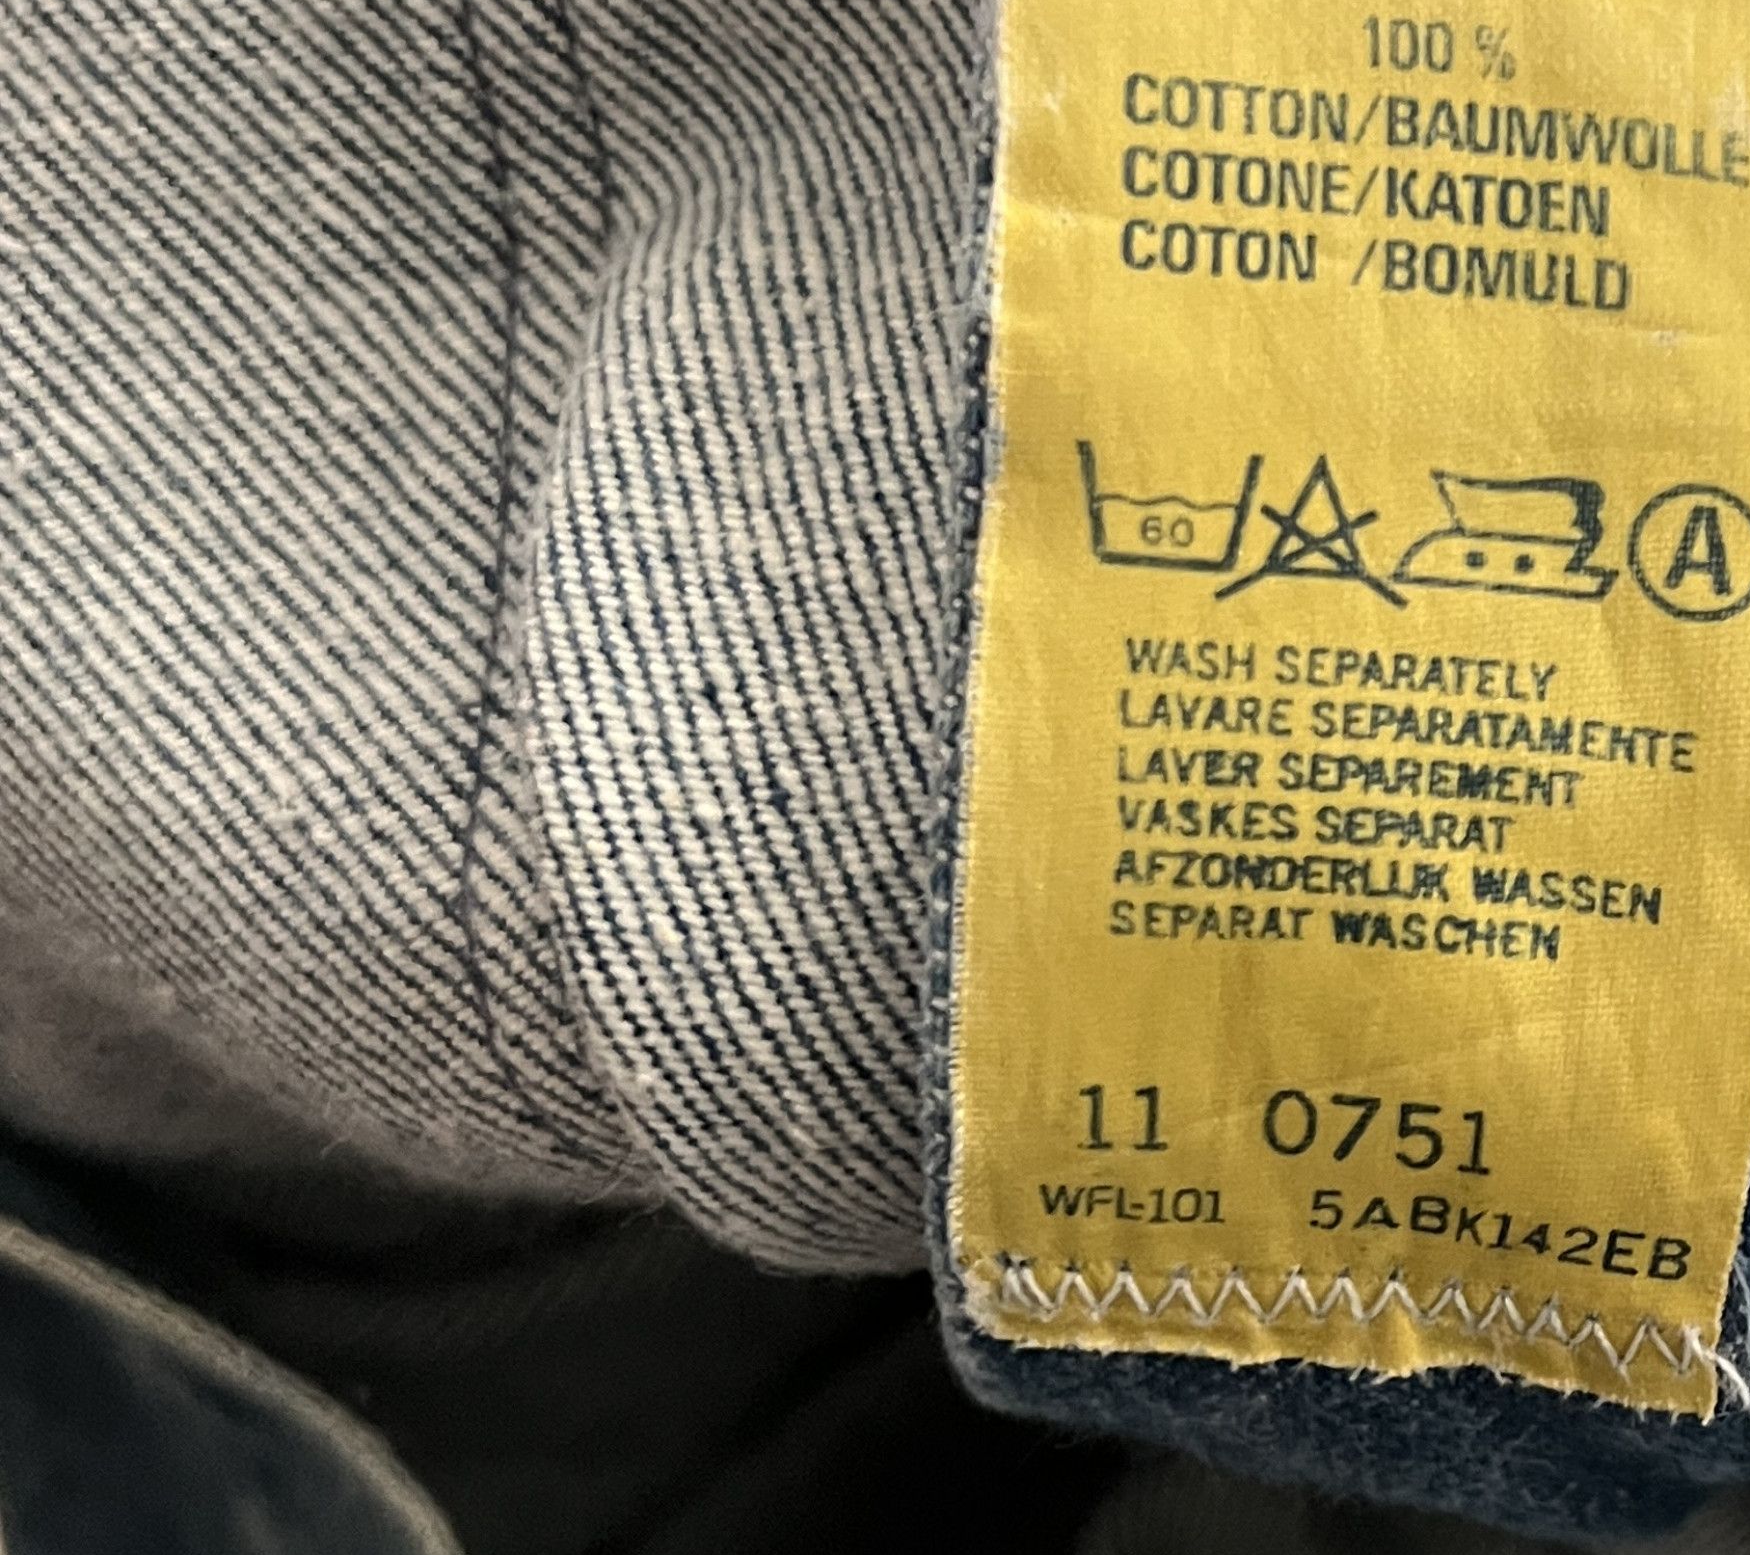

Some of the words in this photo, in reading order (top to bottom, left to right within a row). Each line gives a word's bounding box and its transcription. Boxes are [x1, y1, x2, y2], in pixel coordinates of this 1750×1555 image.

[1362, 16, 1455, 75] 100
[1475, 24, 1517, 81] %
[1123, 71, 1750, 188] COTTON/BAUMWOLLE
[1122, 145, 1611, 239] COTONE/KATOEN
[1121, 219, 1318, 285] COTON
[1139, 515, 1195, 549] 60
[1663, 504, 1732, 597] A
[1125, 637, 1257, 680] WASH
[1275, 646, 1558, 702] SEPARATELY
[1119, 690, 1294, 736] LAVARE
[1311, 701, 1697, 774] SEPARATAMENTE
[1117, 747, 1260, 788] LAVER
[1278, 751, 1584, 808] SEPAREMENT
[1117, 796, 1300, 842] VASKES
[1315, 805, 1517, 853] SEPARAT
[1472, 866, 1663, 926] WASSEN
[1108, 900, 1313, 942] SEPARAT
[1332, 909, 1561, 962] WASCHEN
[1076, 1084, 1169, 1153] 11
[1262, 1088, 1493, 1177] 0751
[1039, 1182, 1226, 1225] WFL-101
[1308, 1188, 1695, 1282] 5ABK142EB
